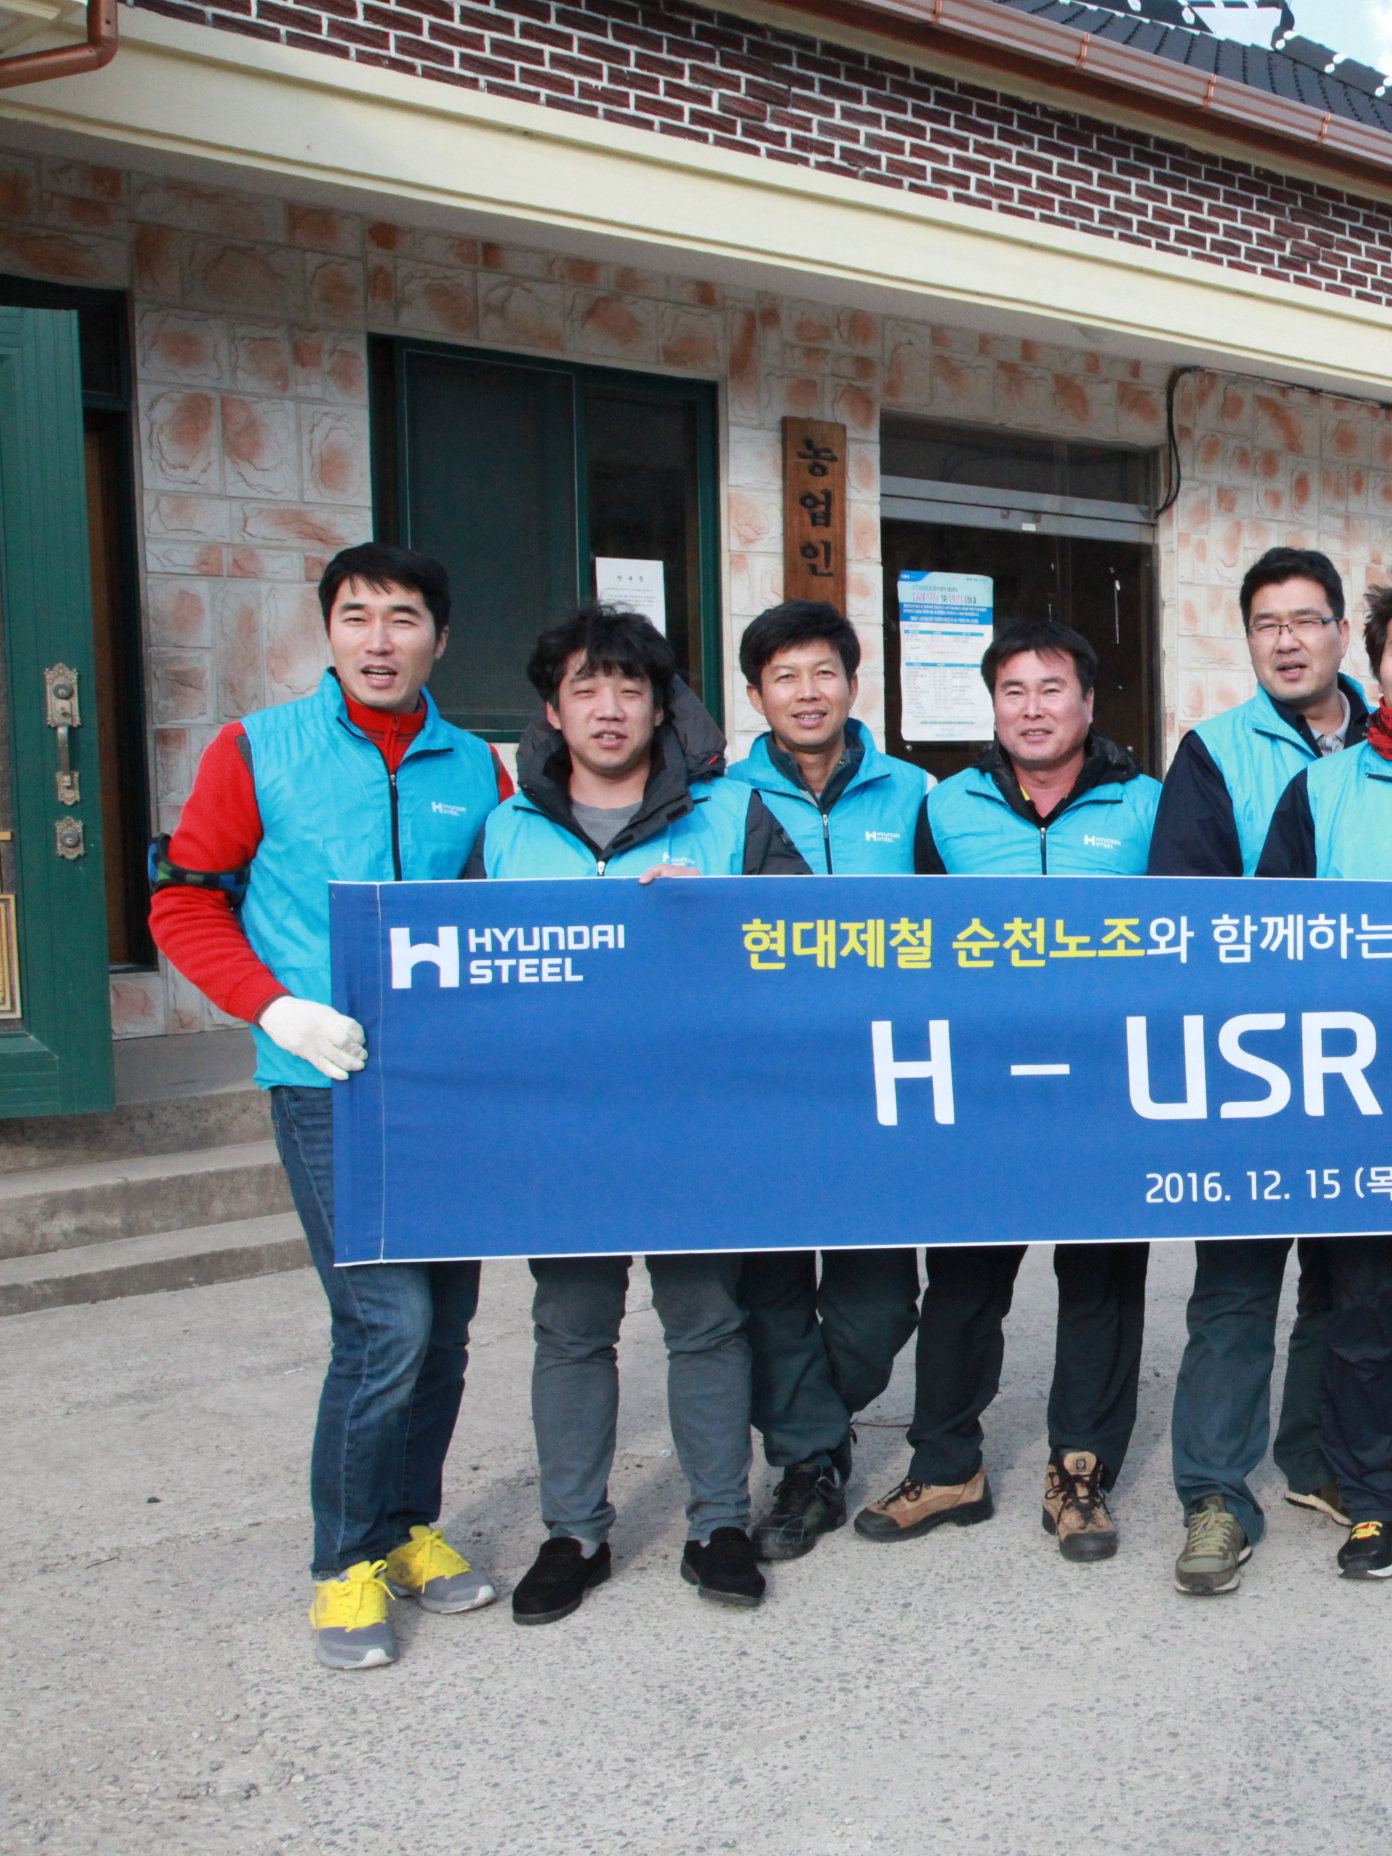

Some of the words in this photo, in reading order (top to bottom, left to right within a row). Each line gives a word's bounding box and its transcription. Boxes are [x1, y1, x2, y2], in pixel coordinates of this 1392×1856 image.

[469, 925, 626, 954] HYUNDAI
[742, 918, 933, 971] 현대제철
[953, 916, 1194, 969] 순천노조와
[470, 958, 585, 986] STEEL
[872, 1020, 956, 1127] H
[1127, 1012, 1384, 1122] USR
[1145, 1172, 1231, 1205] 2016.
[1246, 1171, 1290, 1203] 12.
[1305, 1170, 1342, 1201] 15
